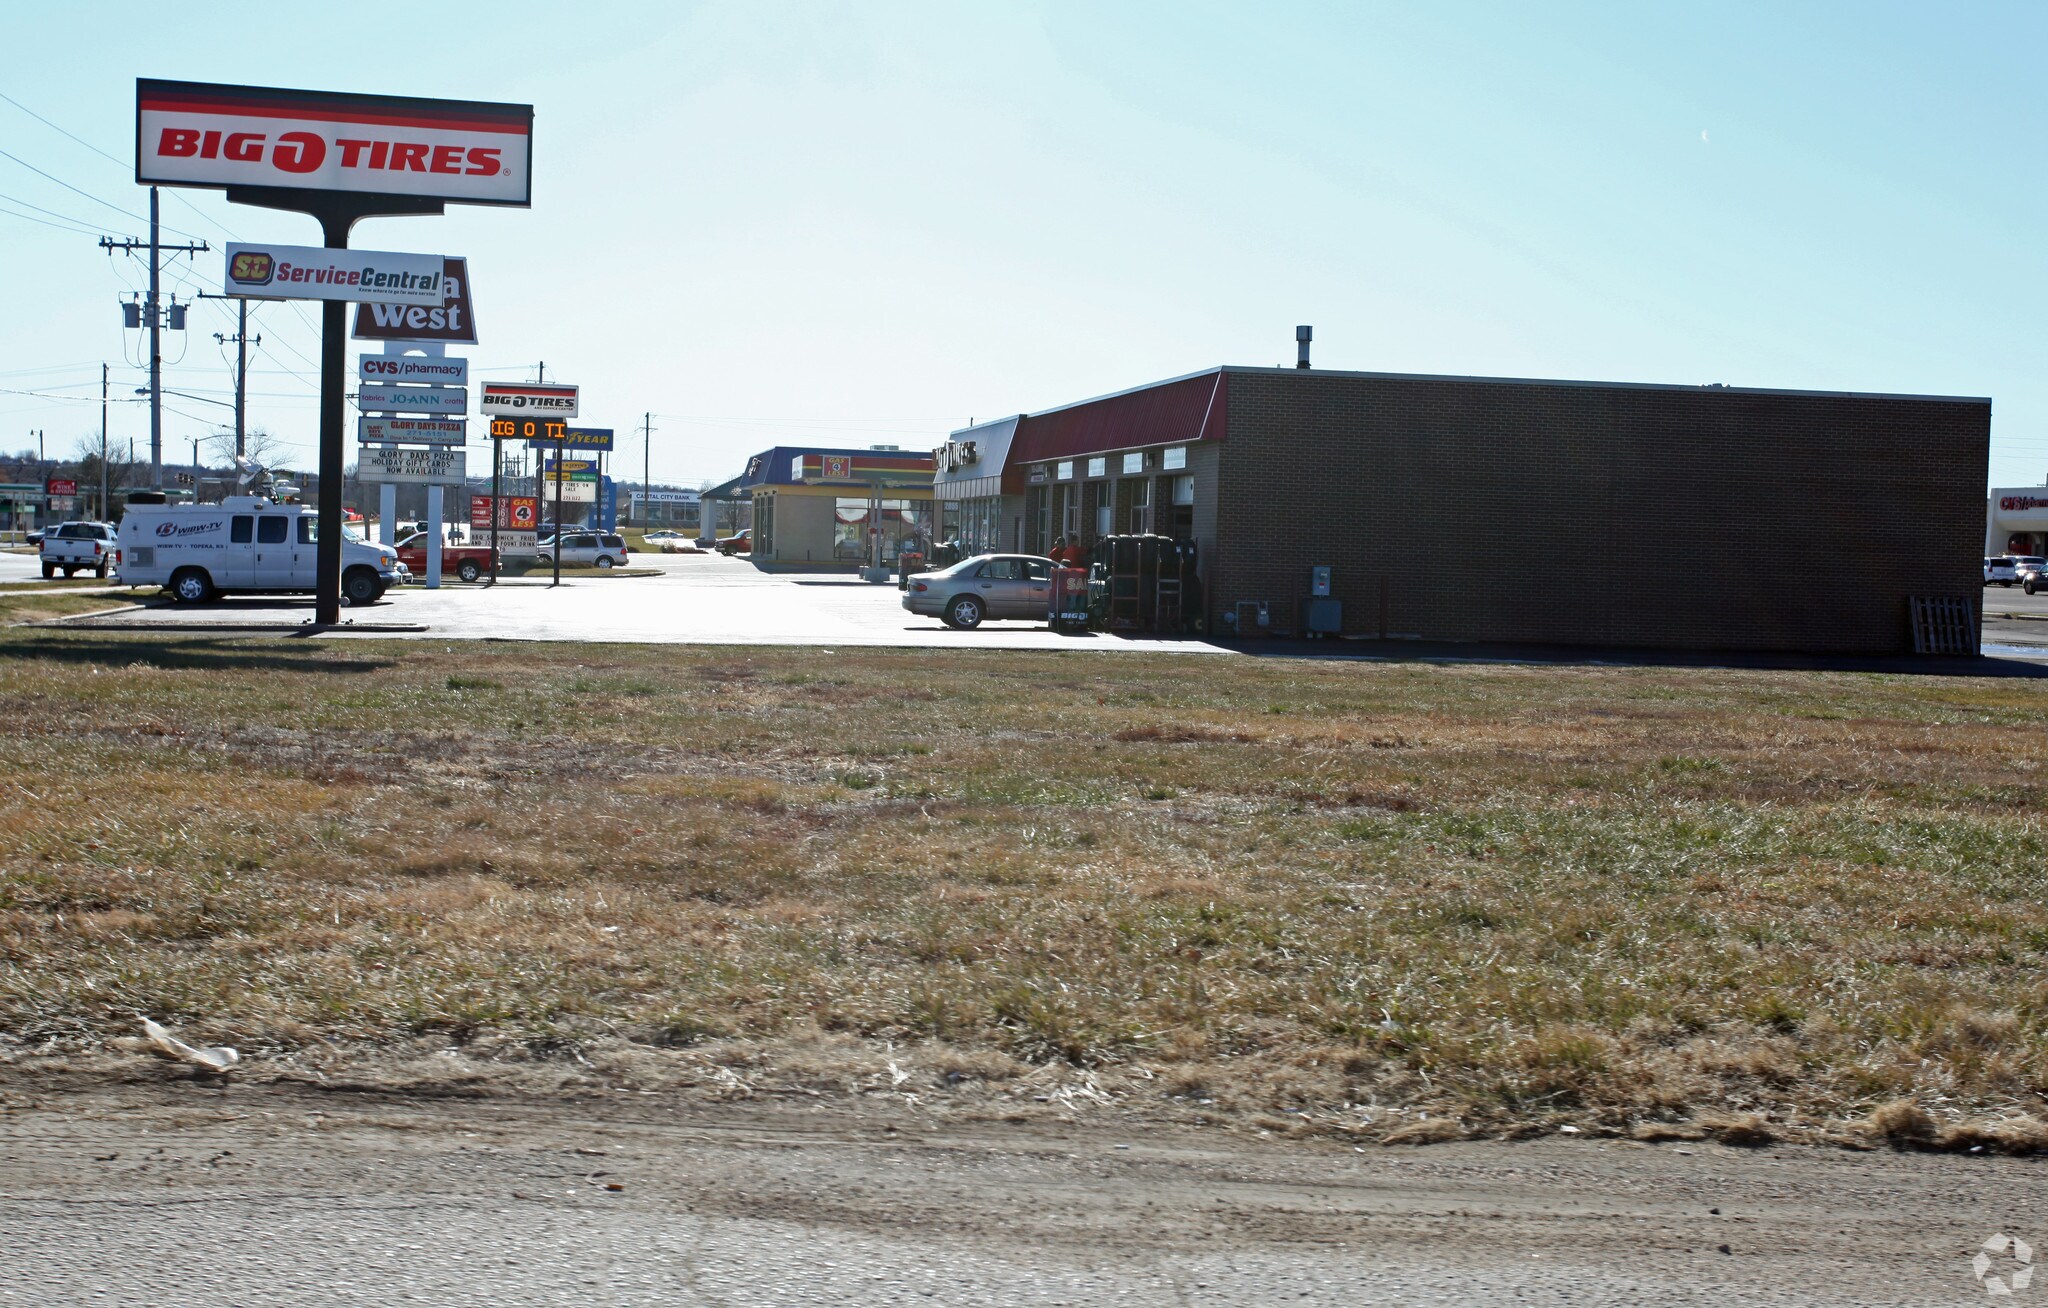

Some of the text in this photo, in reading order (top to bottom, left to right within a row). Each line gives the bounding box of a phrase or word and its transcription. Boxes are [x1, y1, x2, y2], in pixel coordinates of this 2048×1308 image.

[157, 128, 502, 177] BIG O TIRES
[277, 262, 440, 291] ServiceCentral
[370, 303, 462, 331] West
[363, 360, 463, 377] CVS/pharmacy
[361, 394, 385, 402] fabrics
[483, 395, 511, 405] BIG
[528, 397, 575, 408] TIRES
[390, 420, 461, 431] GLORY DAYS PIZZA
[524, 421, 536, 437] O
[378, 450, 455, 460] GLORY DAYS PIZZA
[371, 458, 451, 468] HOLIDAY GIFT CARDS
[833, 463, 840, 471] 4
[406, 467, 446, 475] AVAILABLE
[516, 507, 530, 519] 4
